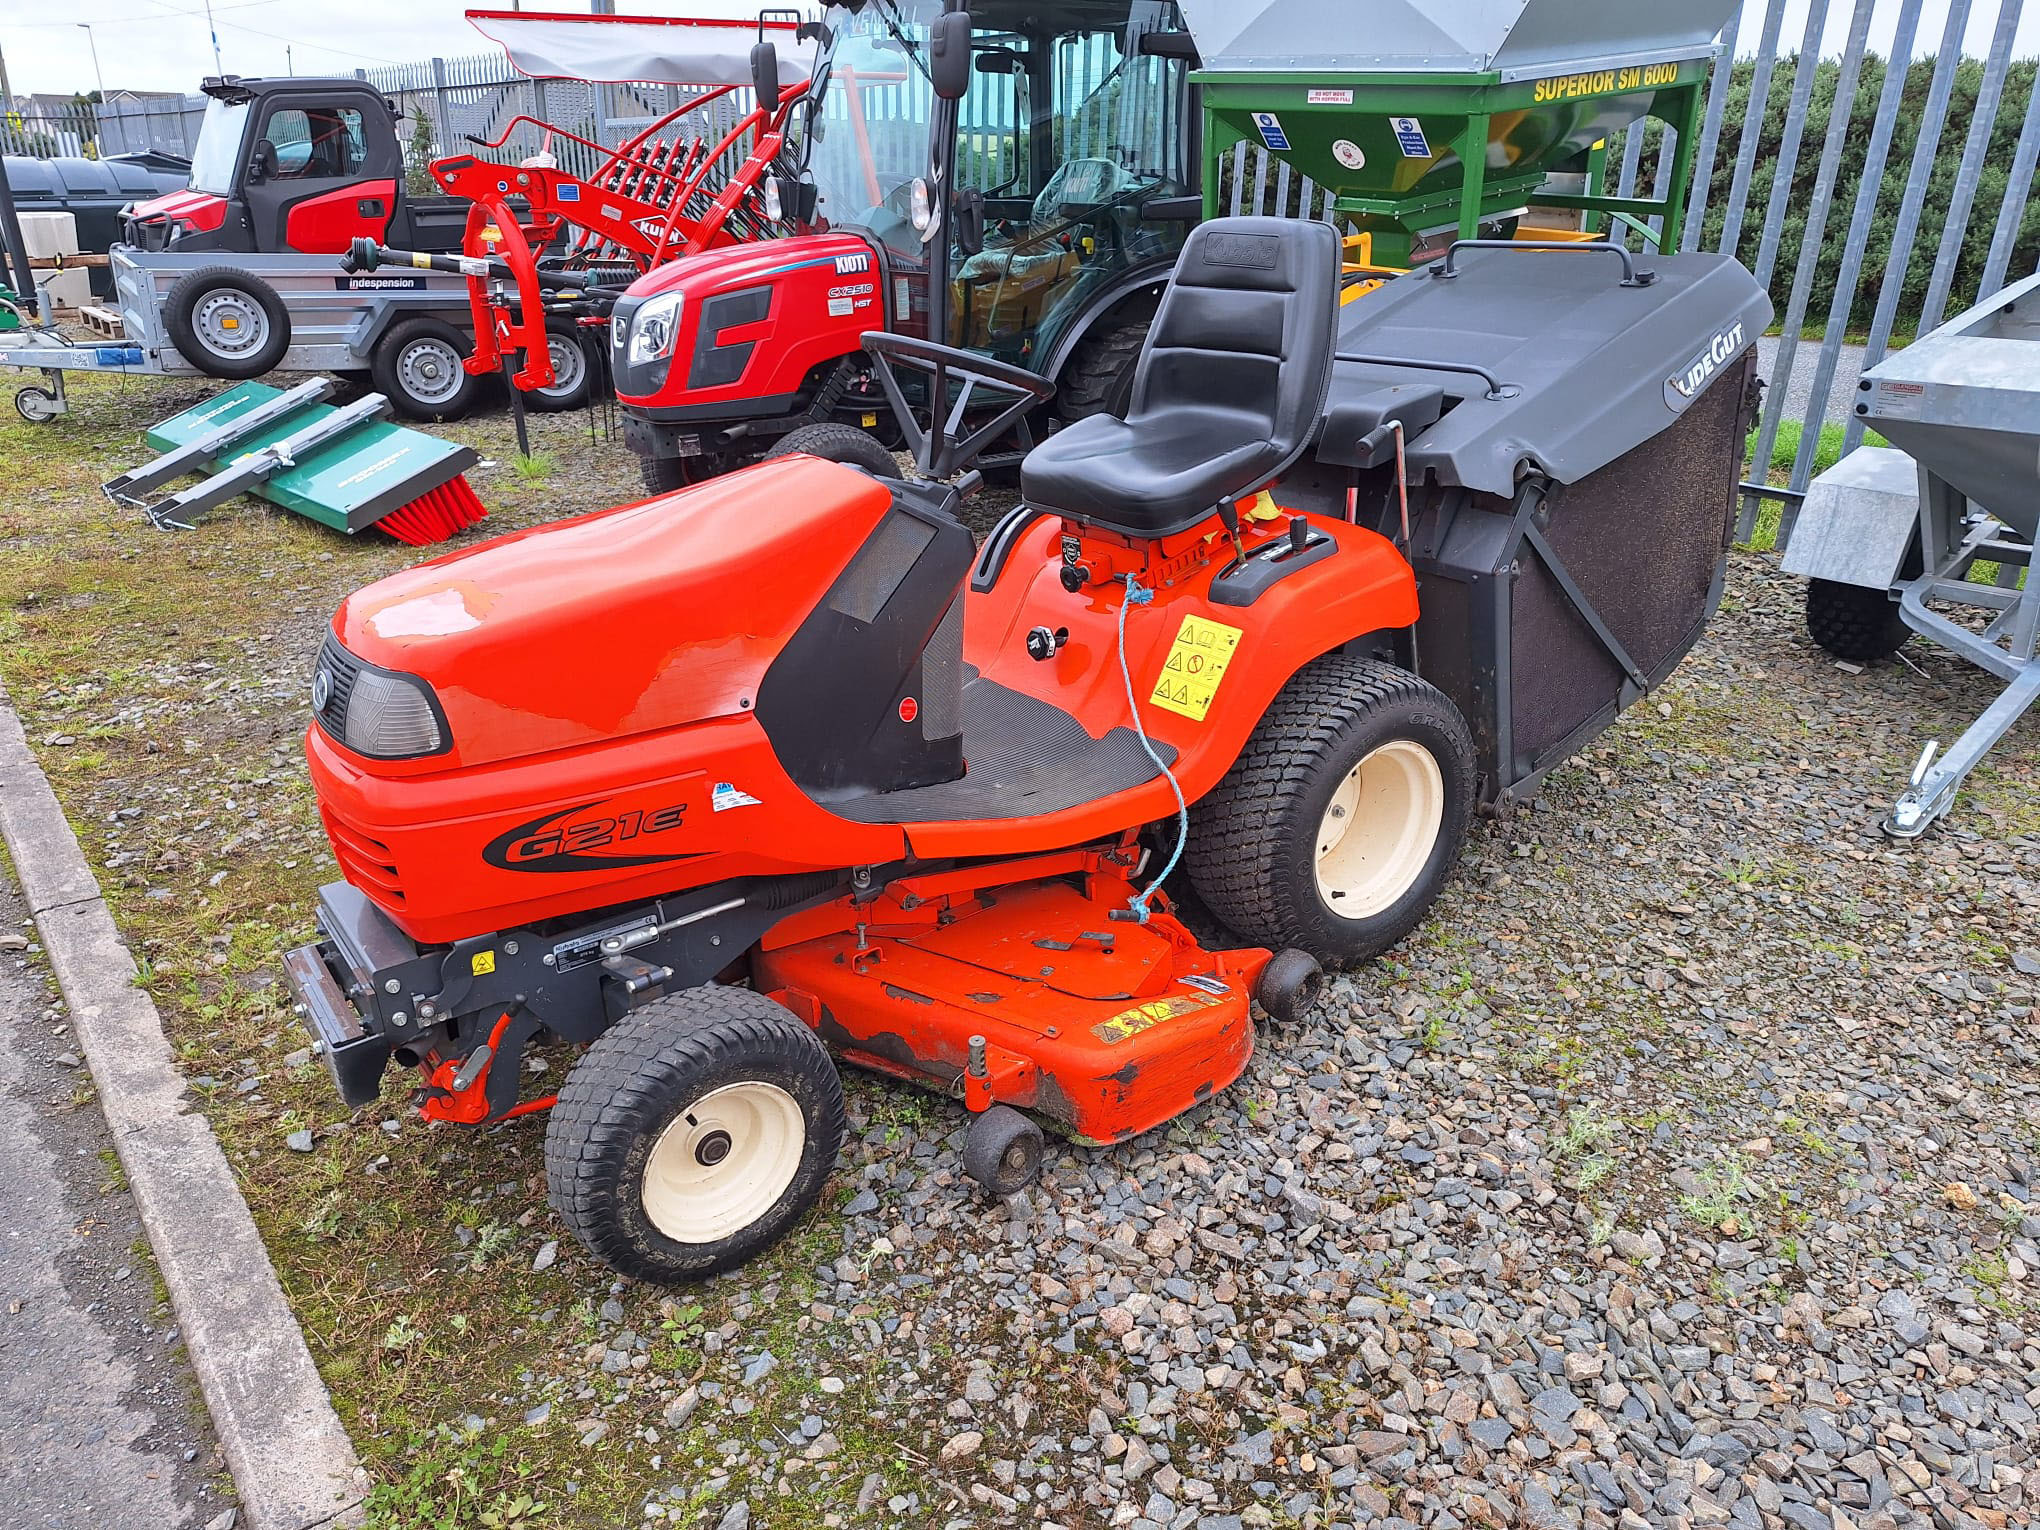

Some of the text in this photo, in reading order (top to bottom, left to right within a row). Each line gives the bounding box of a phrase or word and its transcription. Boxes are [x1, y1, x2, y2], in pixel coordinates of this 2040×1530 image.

[1534, 63, 1678, 102] SUPERIOR SM 6000
[835, 254, 868, 274] KIOTI
[349, 277, 415, 290] indespension
[828, 284, 873, 298] CX2510
[854, 299, 872, 308] HST
[505, 804, 688, 863] G21E
